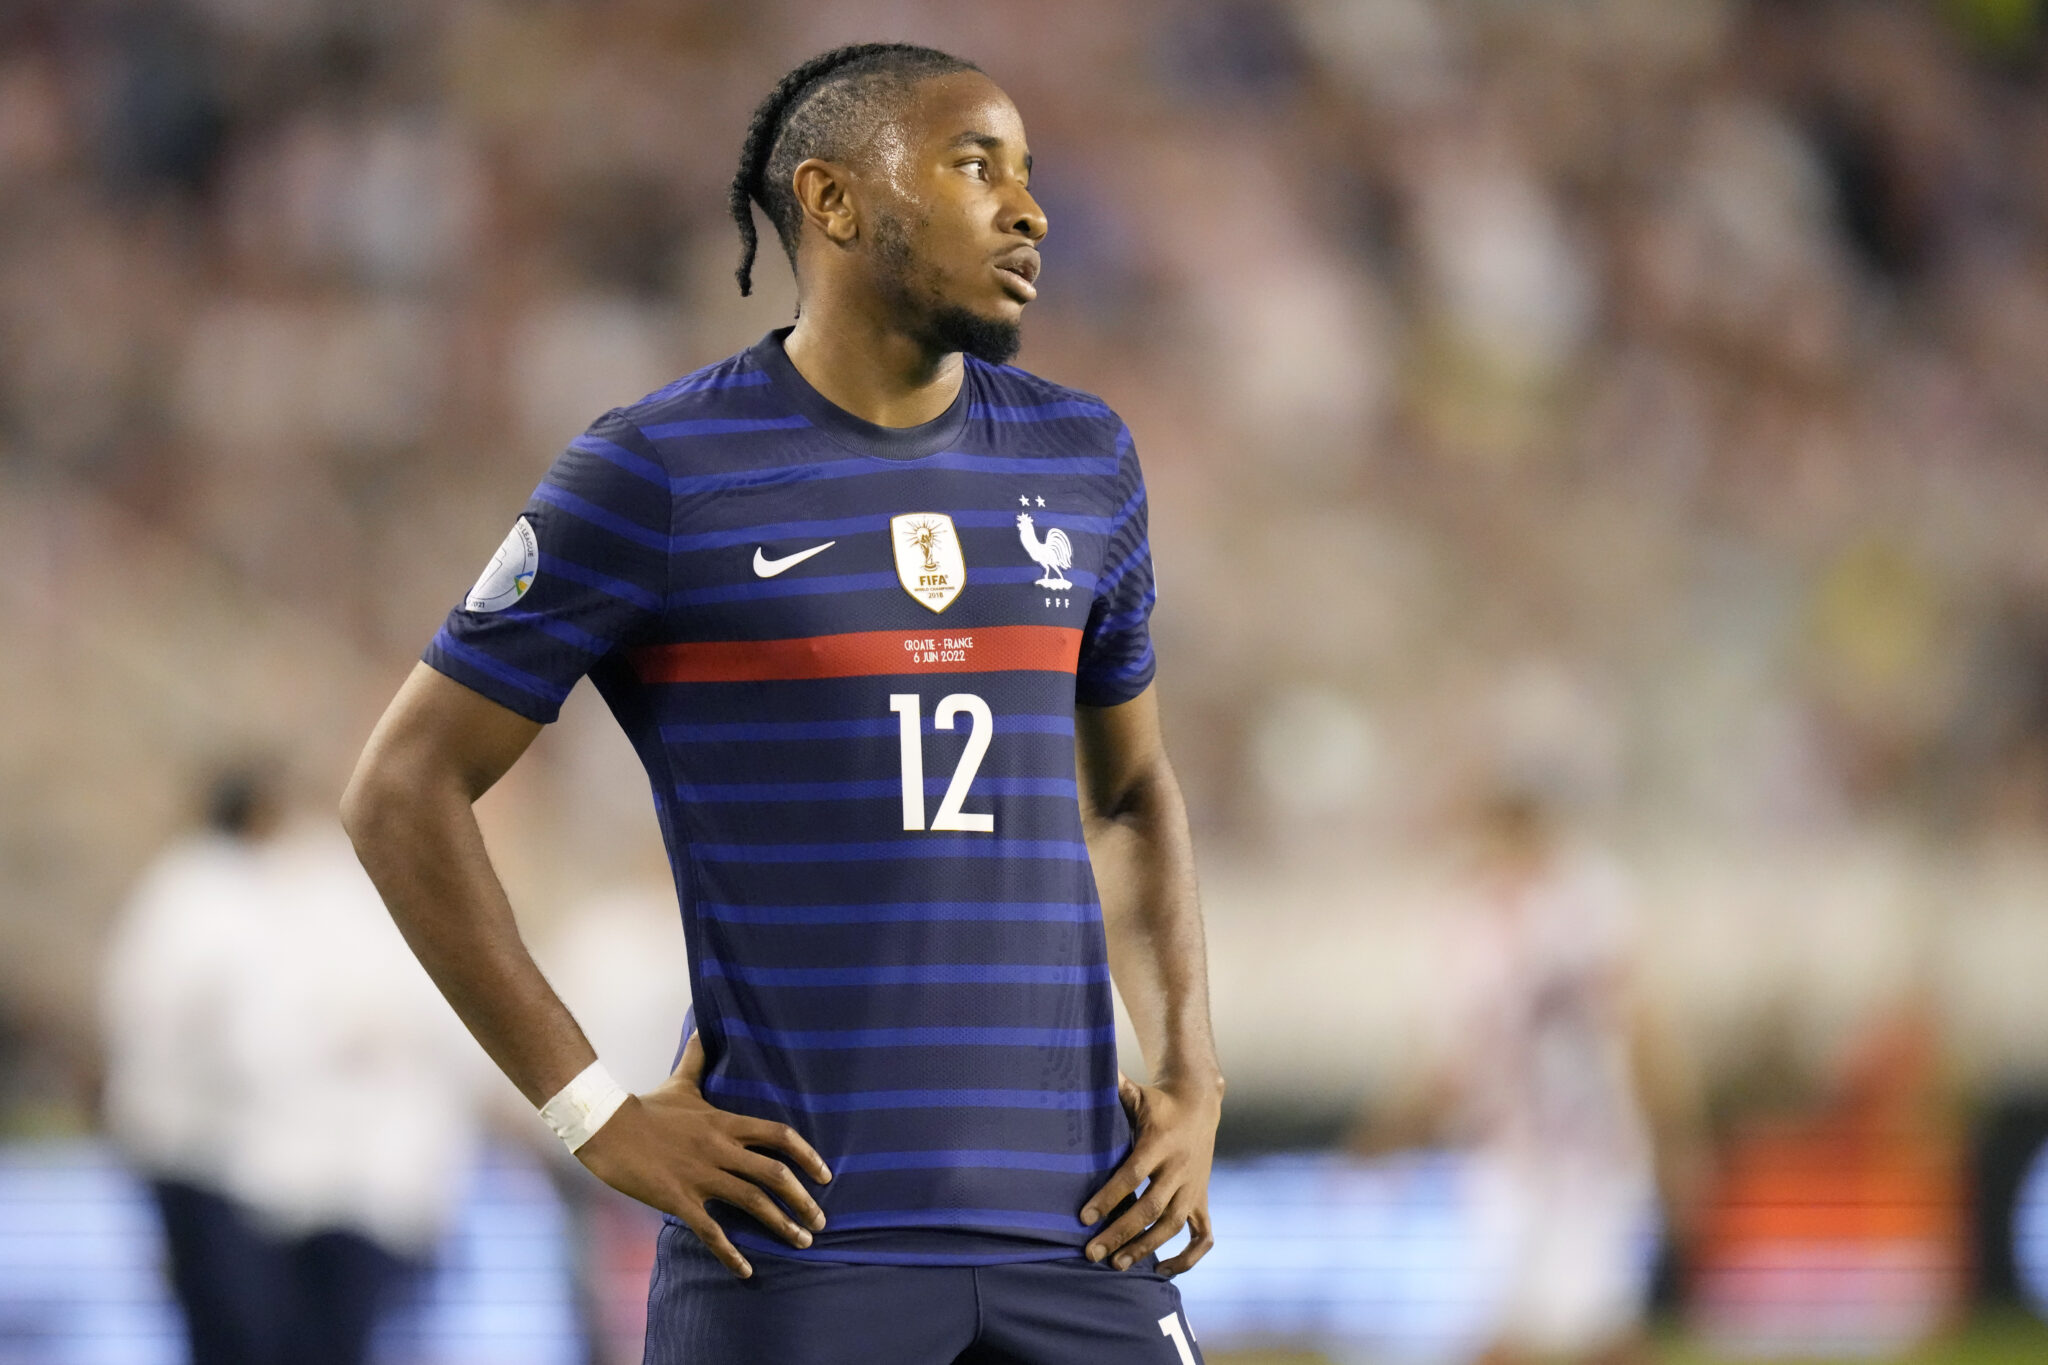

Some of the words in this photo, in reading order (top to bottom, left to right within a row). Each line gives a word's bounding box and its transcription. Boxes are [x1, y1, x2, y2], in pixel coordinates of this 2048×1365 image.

[521, 528, 534, 558] LEAGUE
[904, 639, 936, 651] CROATIE
[943, 636, 974, 650] FRANCE
[913, 651, 920, 664] 6
[922, 651, 939, 663] JUIN
[940, 649, 966, 662] 2022
[890, 693, 994, 832] 12
[1157, 1311, 1197, 1365] 1
